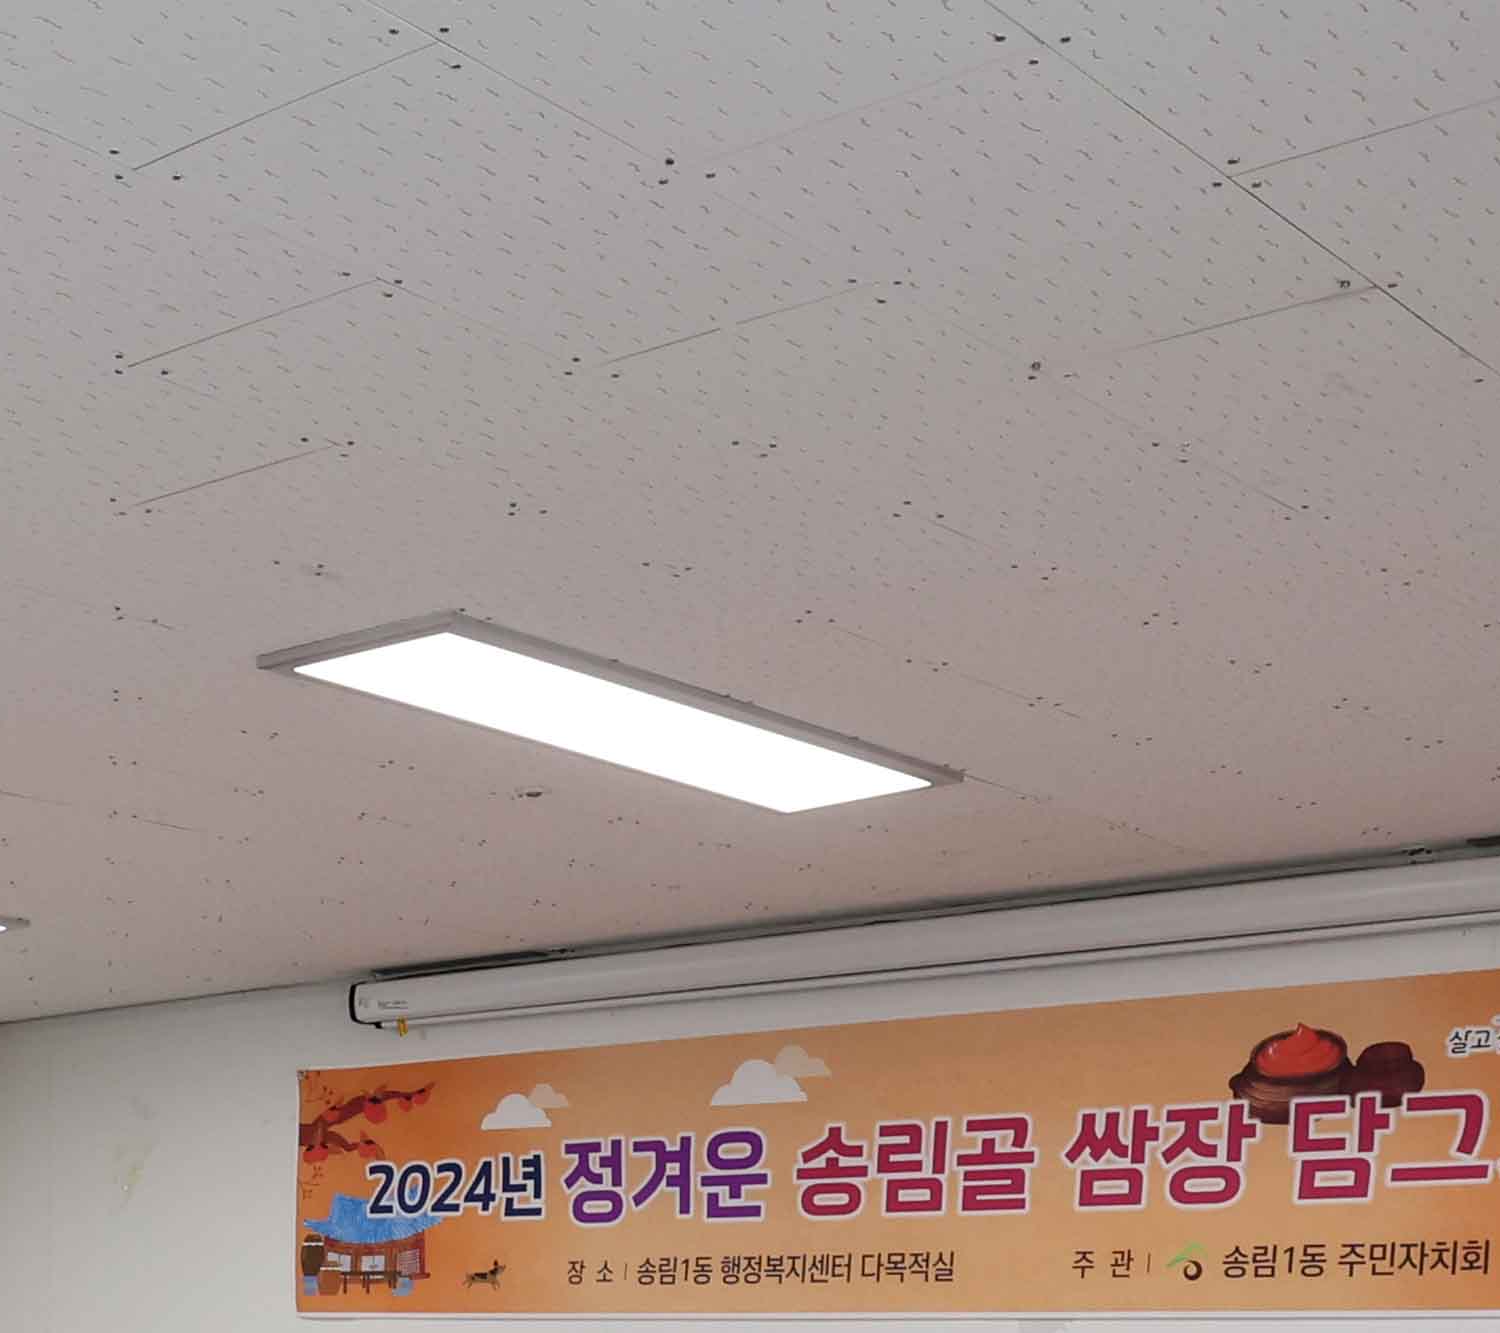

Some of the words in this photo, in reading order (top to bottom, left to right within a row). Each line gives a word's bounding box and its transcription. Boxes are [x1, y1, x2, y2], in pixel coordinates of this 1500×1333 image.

[1449, 1029, 1491, 1054] 살고
[366, 1151, 545, 1219] 2024년
[560, 1128, 770, 1226] 정겨운
[794, 1116, 1037, 1218] 송림골
[1064, 1102, 1259, 1207] 쌈장
[636, 1257, 713, 1285] 송림1동
[720, 1252, 853, 1285] 행정복지센터
[860, 1250, 956, 1283] 다목적실
[1221, 1244, 1327, 1279] 송림1동
[1337, 1239, 1491, 1277] 주민자치회
